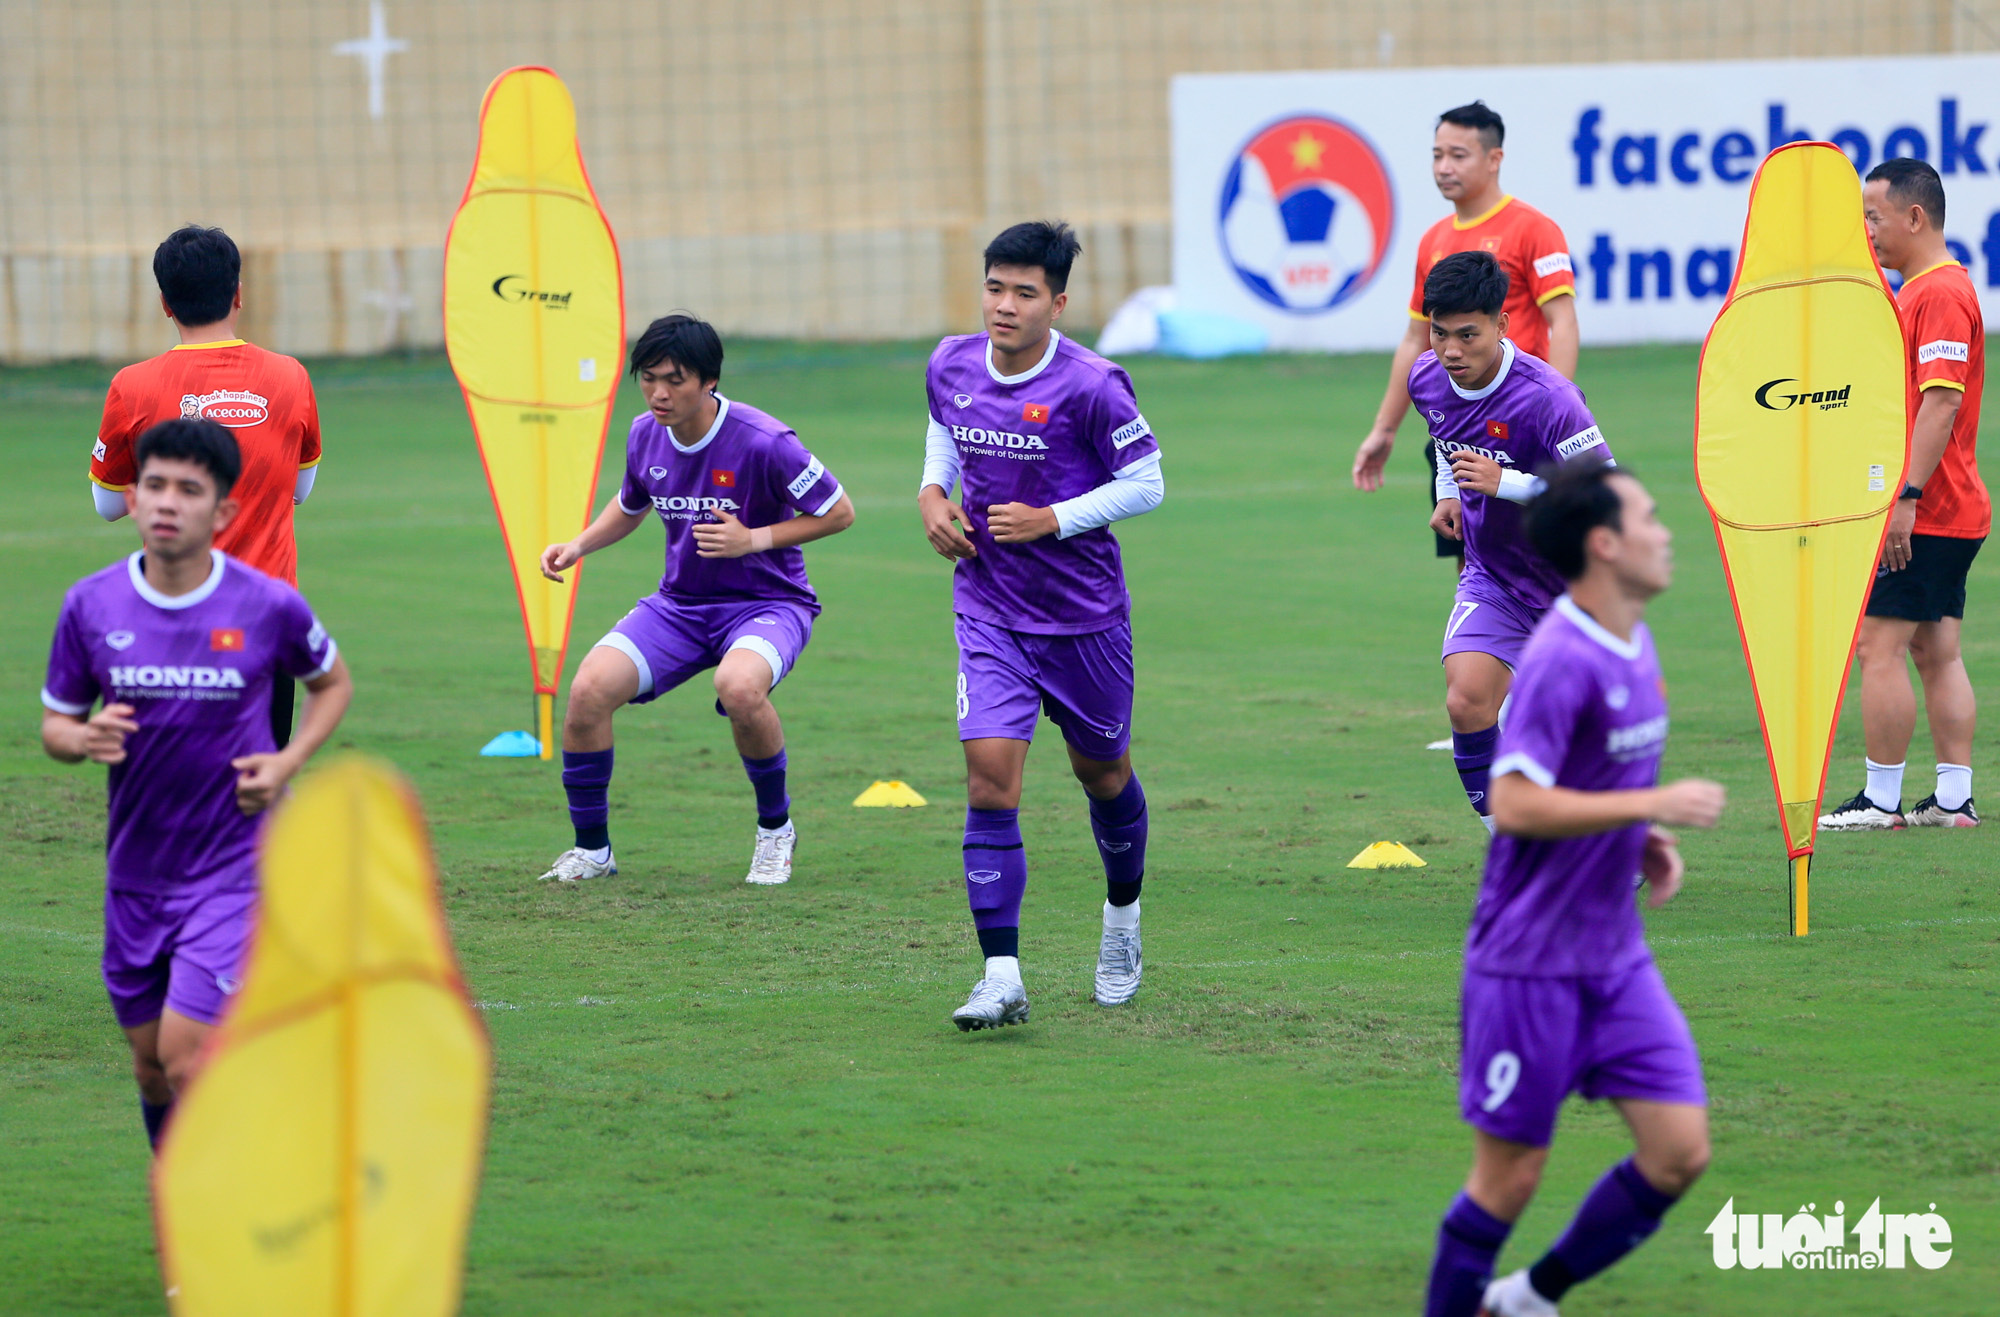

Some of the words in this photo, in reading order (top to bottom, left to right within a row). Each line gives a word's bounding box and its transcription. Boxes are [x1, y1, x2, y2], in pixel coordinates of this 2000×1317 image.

[1573, 96, 2000, 187] faceook
[493, 274, 572, 304] Grand
[1920, 344, 1967, 359] VINAMILK
[200, 391, 221, 404] Cook
[223, 391, 266, 405] happiness
[1754, 378, 1851, 411] Grand
[1819, 401, 1848, 411] sport
[951, 424, 1049, 450] HONDA
[1114, 421, 1147, 443] VINA
[969, 446, 996, 456] Power
[997, 450, 1007, 458] of
[1008, 451, 1045, 461] Dreams
[791, 466, 819, 493] VINA
[650, 495, 741, 511] HONDA
[108, 665, 247, 688] HONDA
[956, 671, 970, 721] 8
[1482, 1050, 1521, 1112] 9
